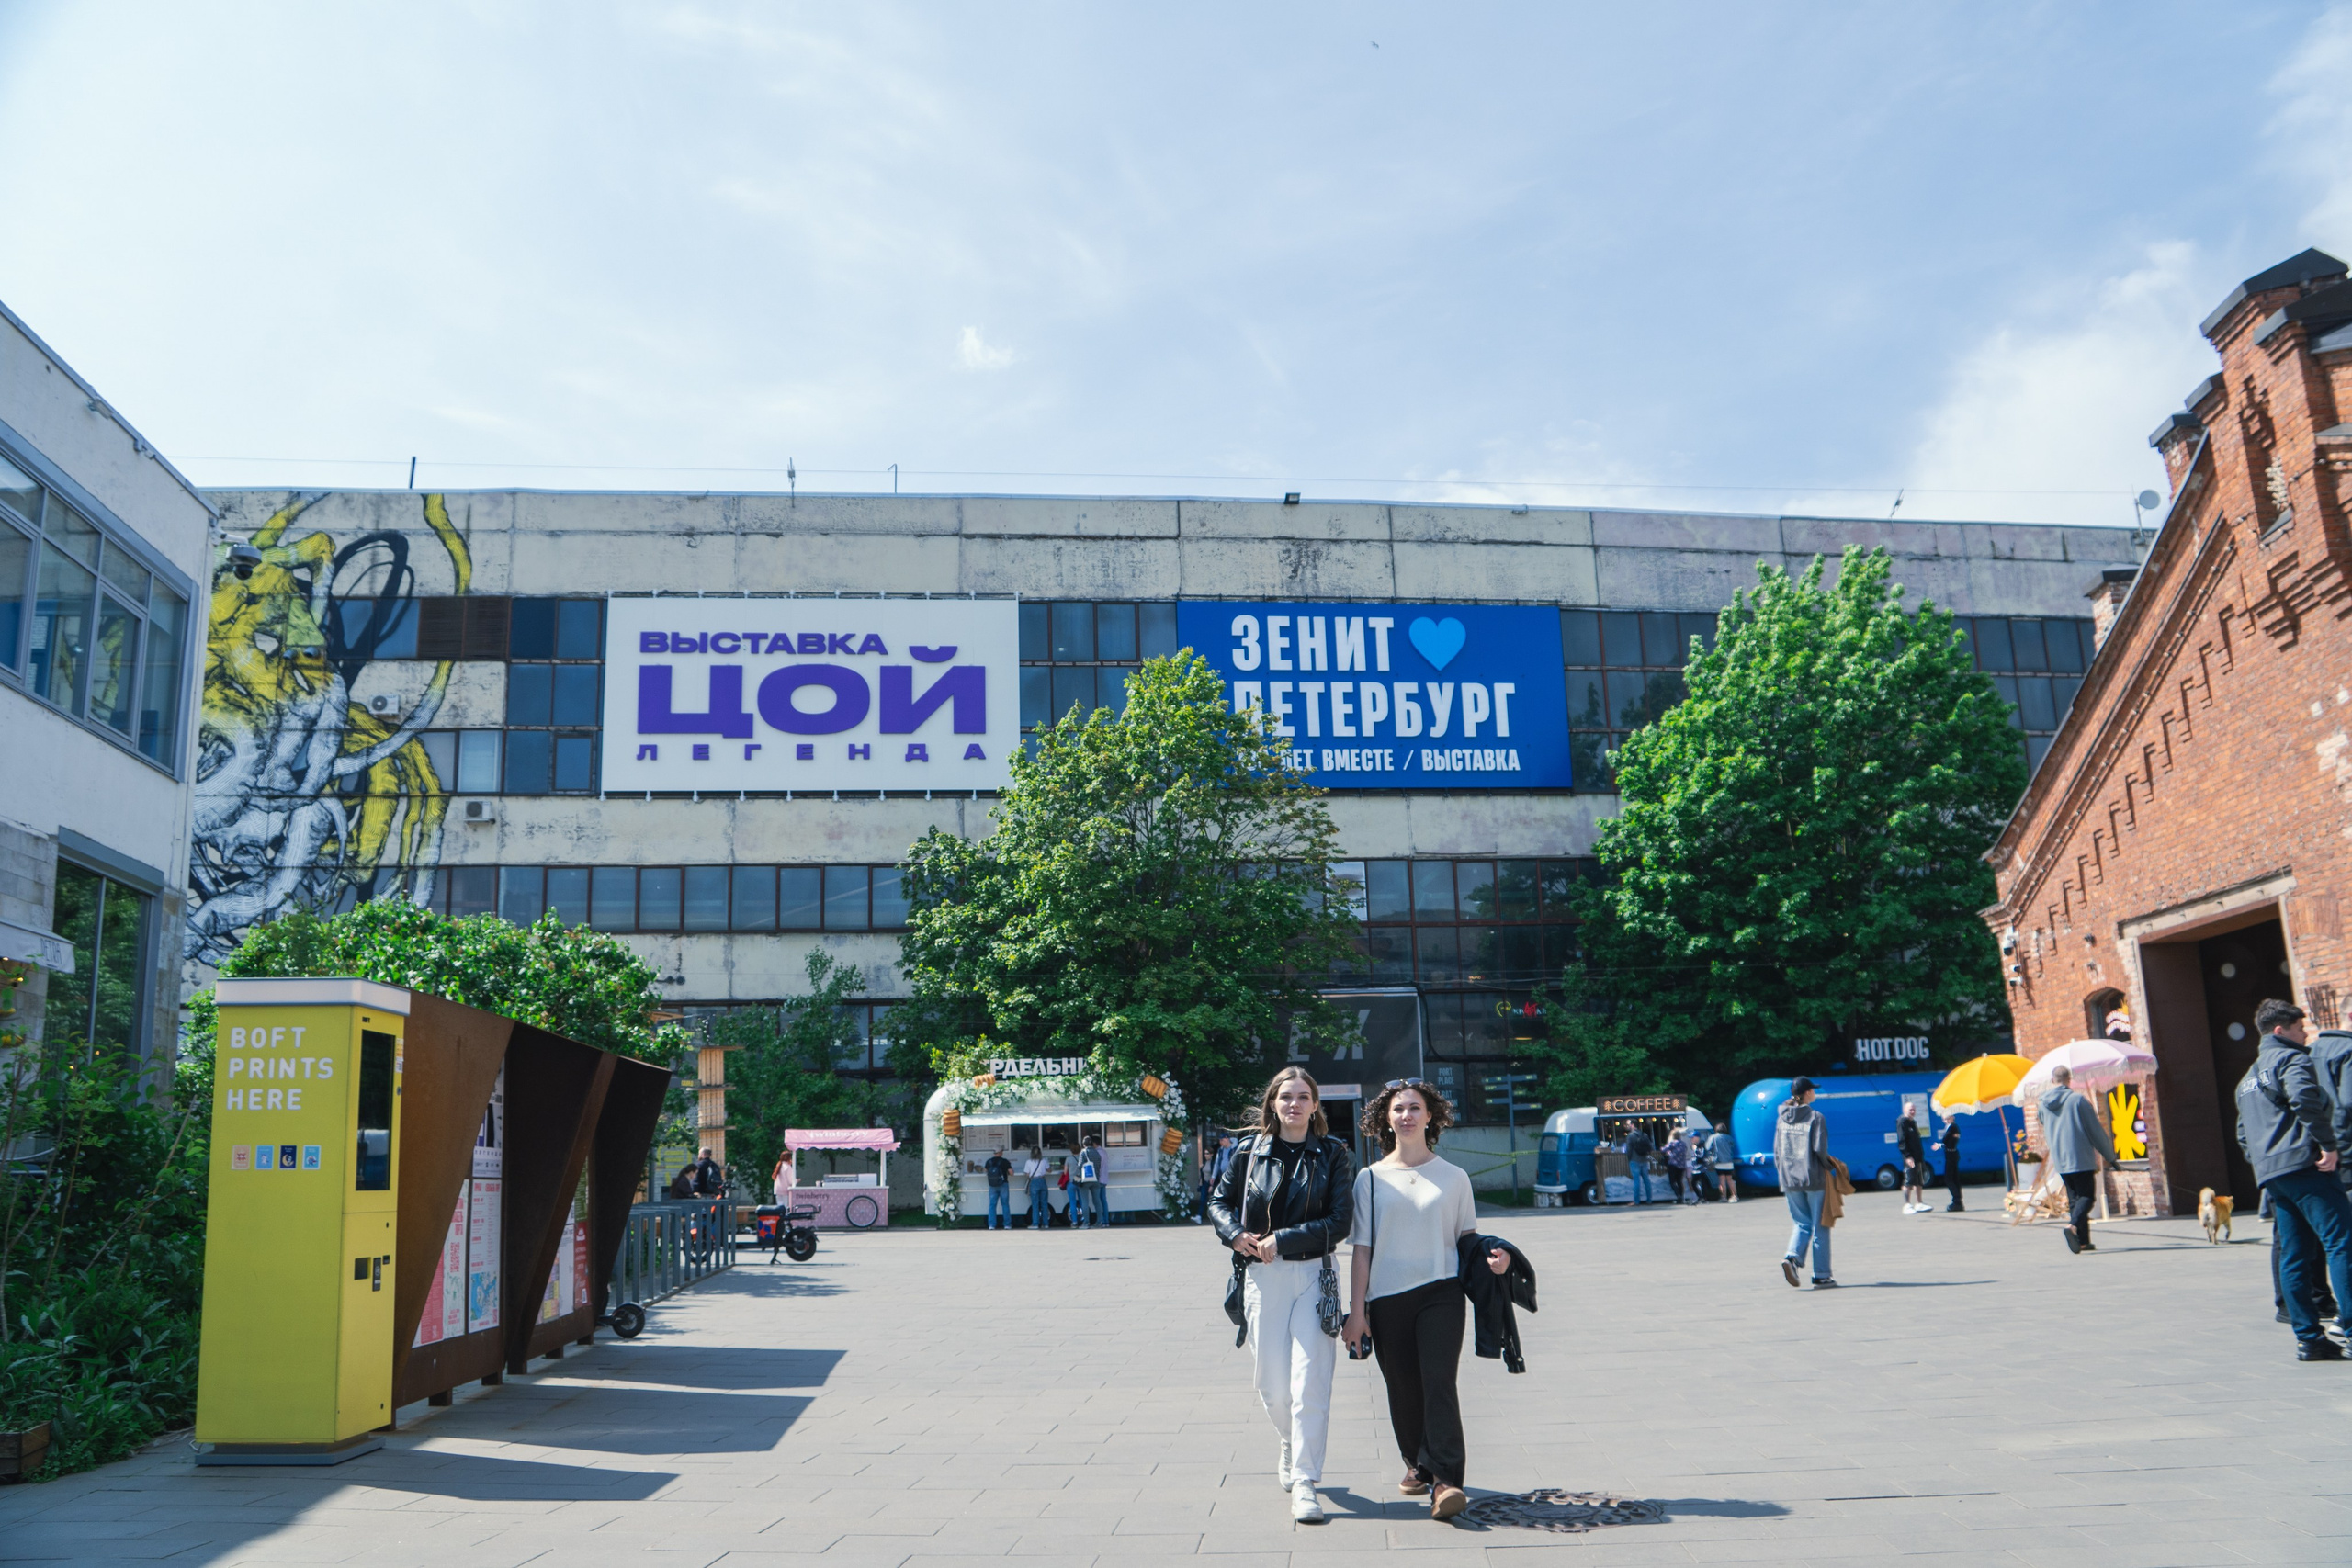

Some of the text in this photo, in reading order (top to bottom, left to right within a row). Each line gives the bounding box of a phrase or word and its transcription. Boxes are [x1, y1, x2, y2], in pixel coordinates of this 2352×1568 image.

[639, 631, 888, 655] ВЫСТАВКА
[1231, 615, 1394, 671] ЗЕНИТ
[638, 645, 987, 739] ЦОЙ
[1232, 681, 1516, 738] ПЕТЕРБУРГ
[637, 743, 987, 762] ЛЕГЕНДА
[1322, 749, 1395, 772] ВМЕСТЕ
[1422, 749, 1521, 772] ВЫСТАВКА
[230, 1027, 306, 1049] BOFT
[228, 1057, 334, 1079] PRINTS
[981, 1057, 1114, 1079] РДЕЛЬН
[226, 1089, 302, 1111] HERE
[1612, 1098, 1671, 1111] COFFEE
